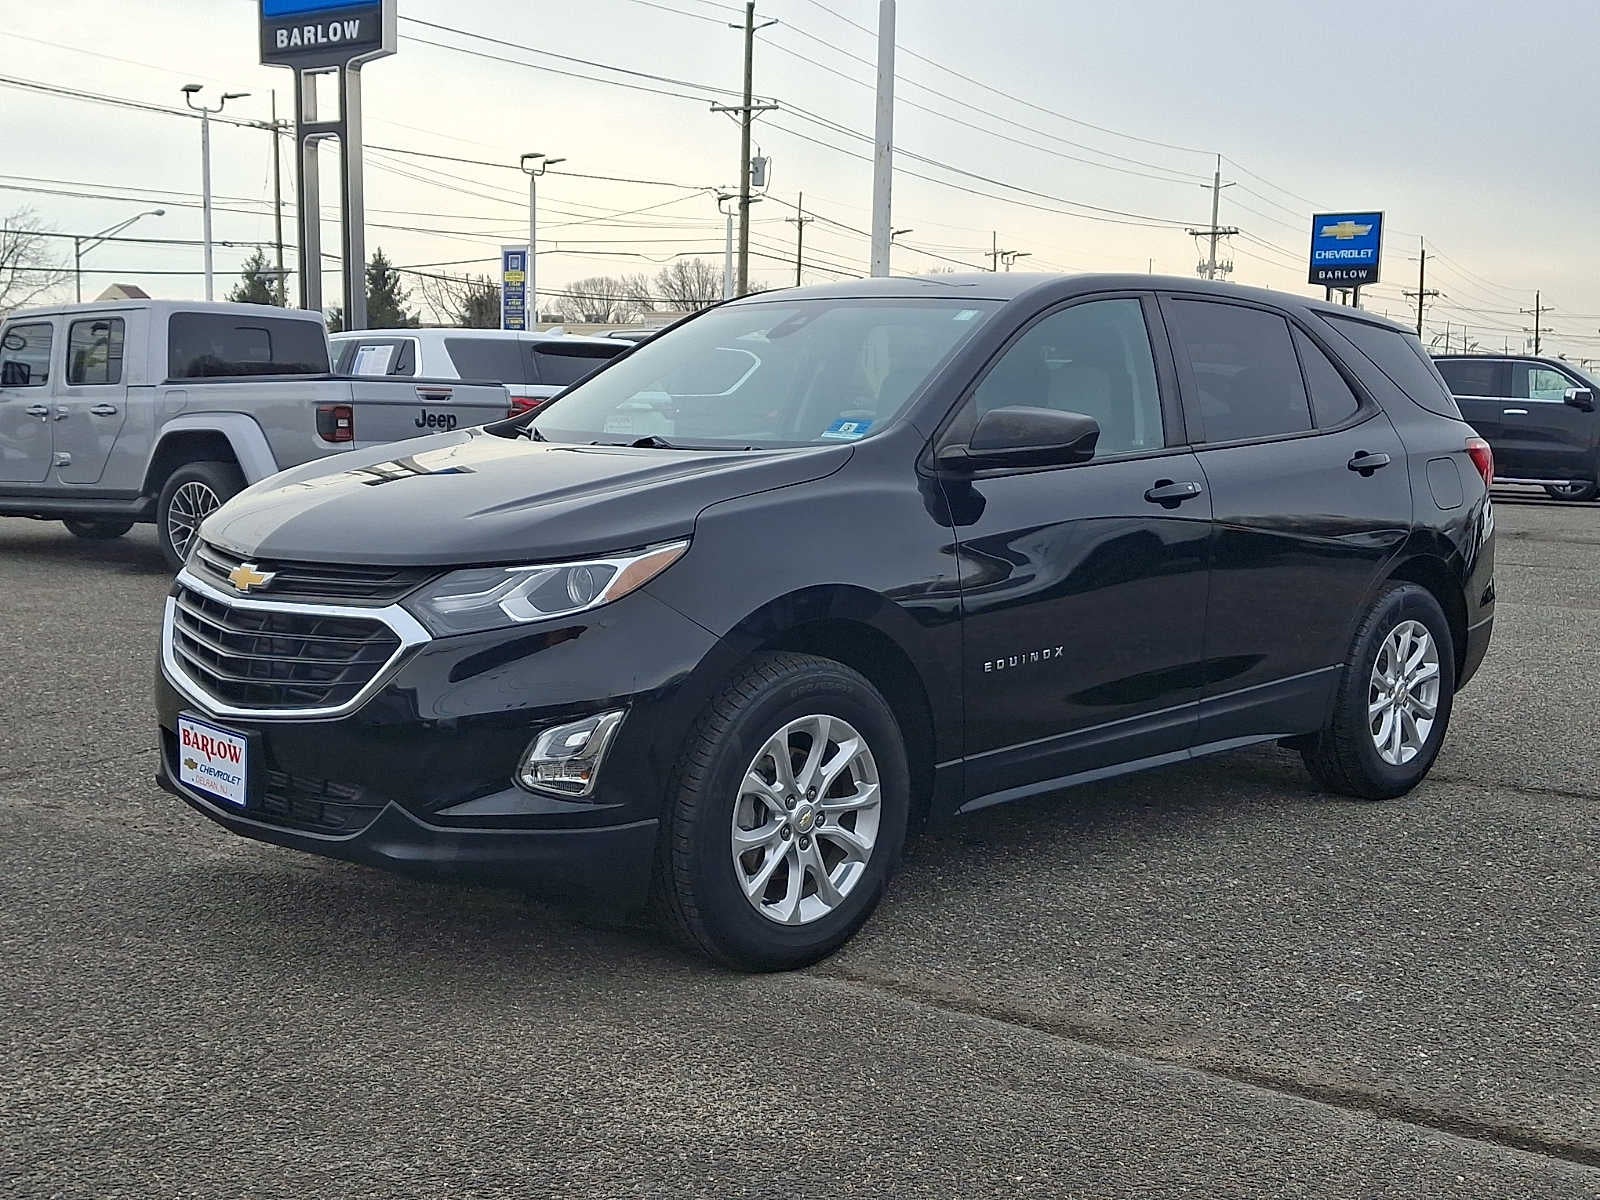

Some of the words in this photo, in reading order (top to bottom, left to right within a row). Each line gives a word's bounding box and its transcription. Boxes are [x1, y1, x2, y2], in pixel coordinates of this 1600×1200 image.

[276, 20, 360, 48] BARLOW
[1315, 248, 1373, 260] CHEVROLET
[1318, 269, 1368, 279] BARLOW
[414, 408, 457, 431] Jeep
[984, 646, 1063, 673] EQUINOX
[182, 727, 242, 764] BARLOW
[199, 763, 241, 786] CHEVROLET
